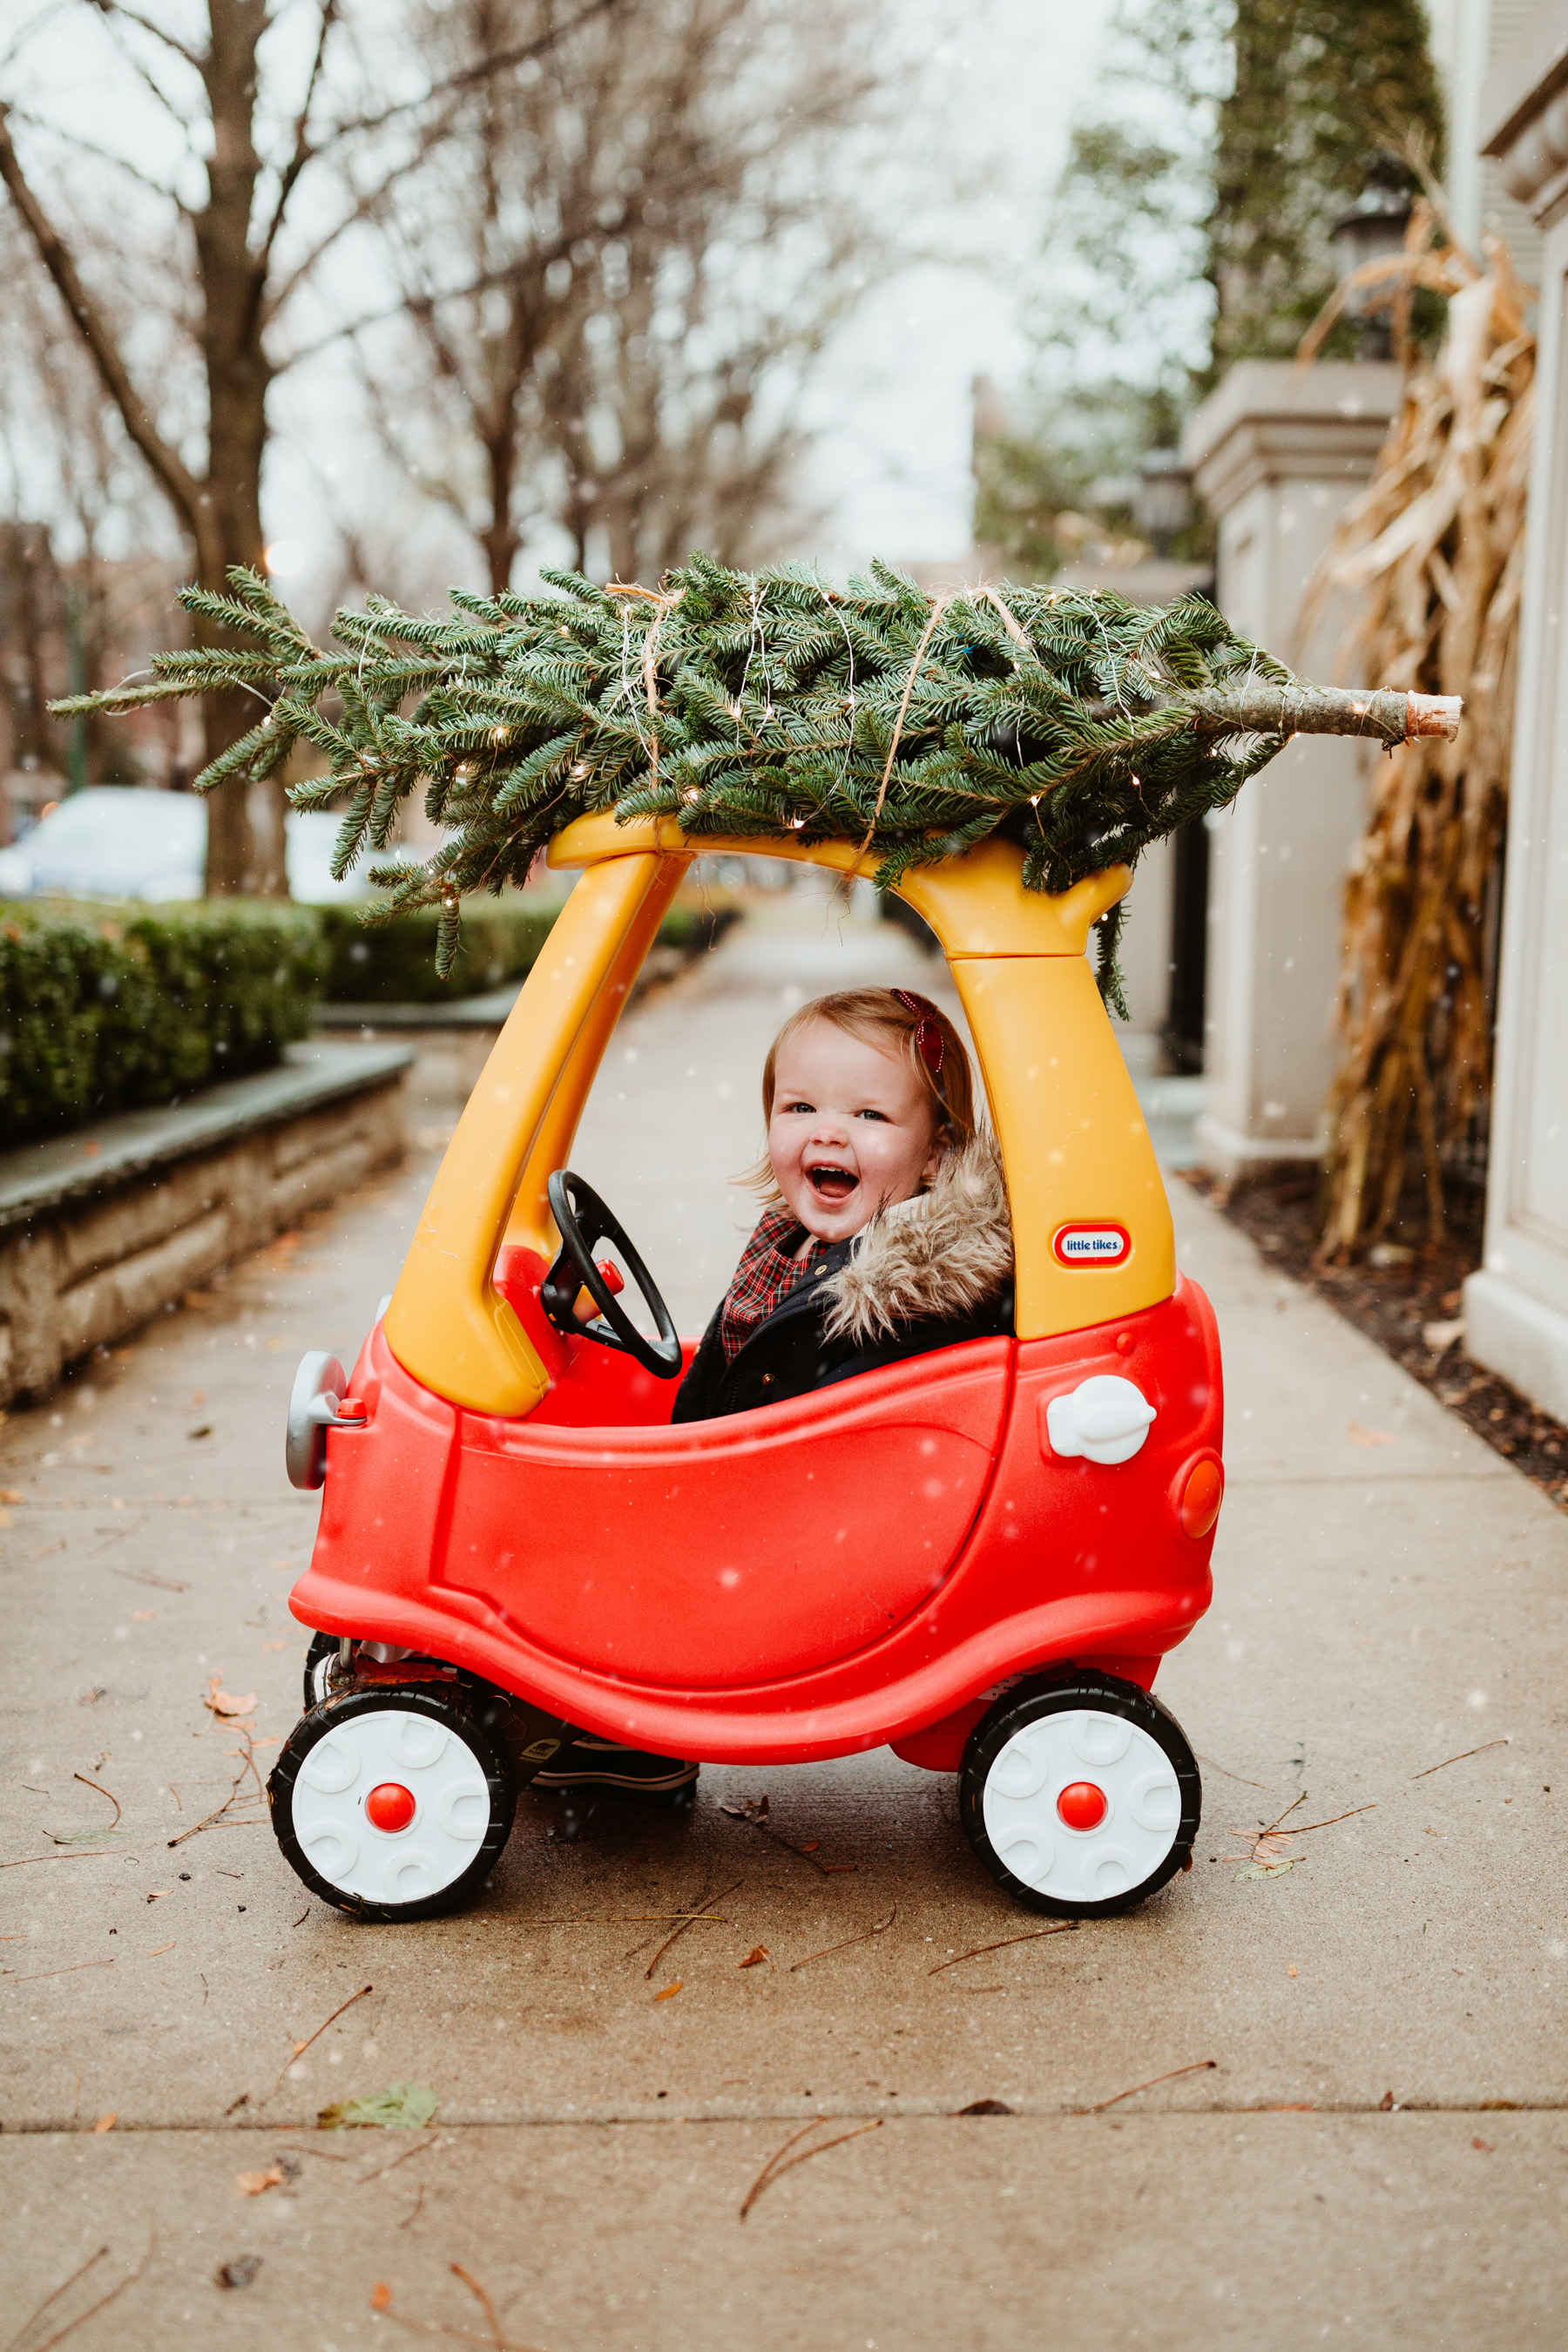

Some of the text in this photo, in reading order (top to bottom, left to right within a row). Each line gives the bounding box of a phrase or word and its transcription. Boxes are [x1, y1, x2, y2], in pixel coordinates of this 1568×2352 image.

[1067, 1239, 1118, 1250] little tikes
[527, 1748, 548, 1757] SOREL
